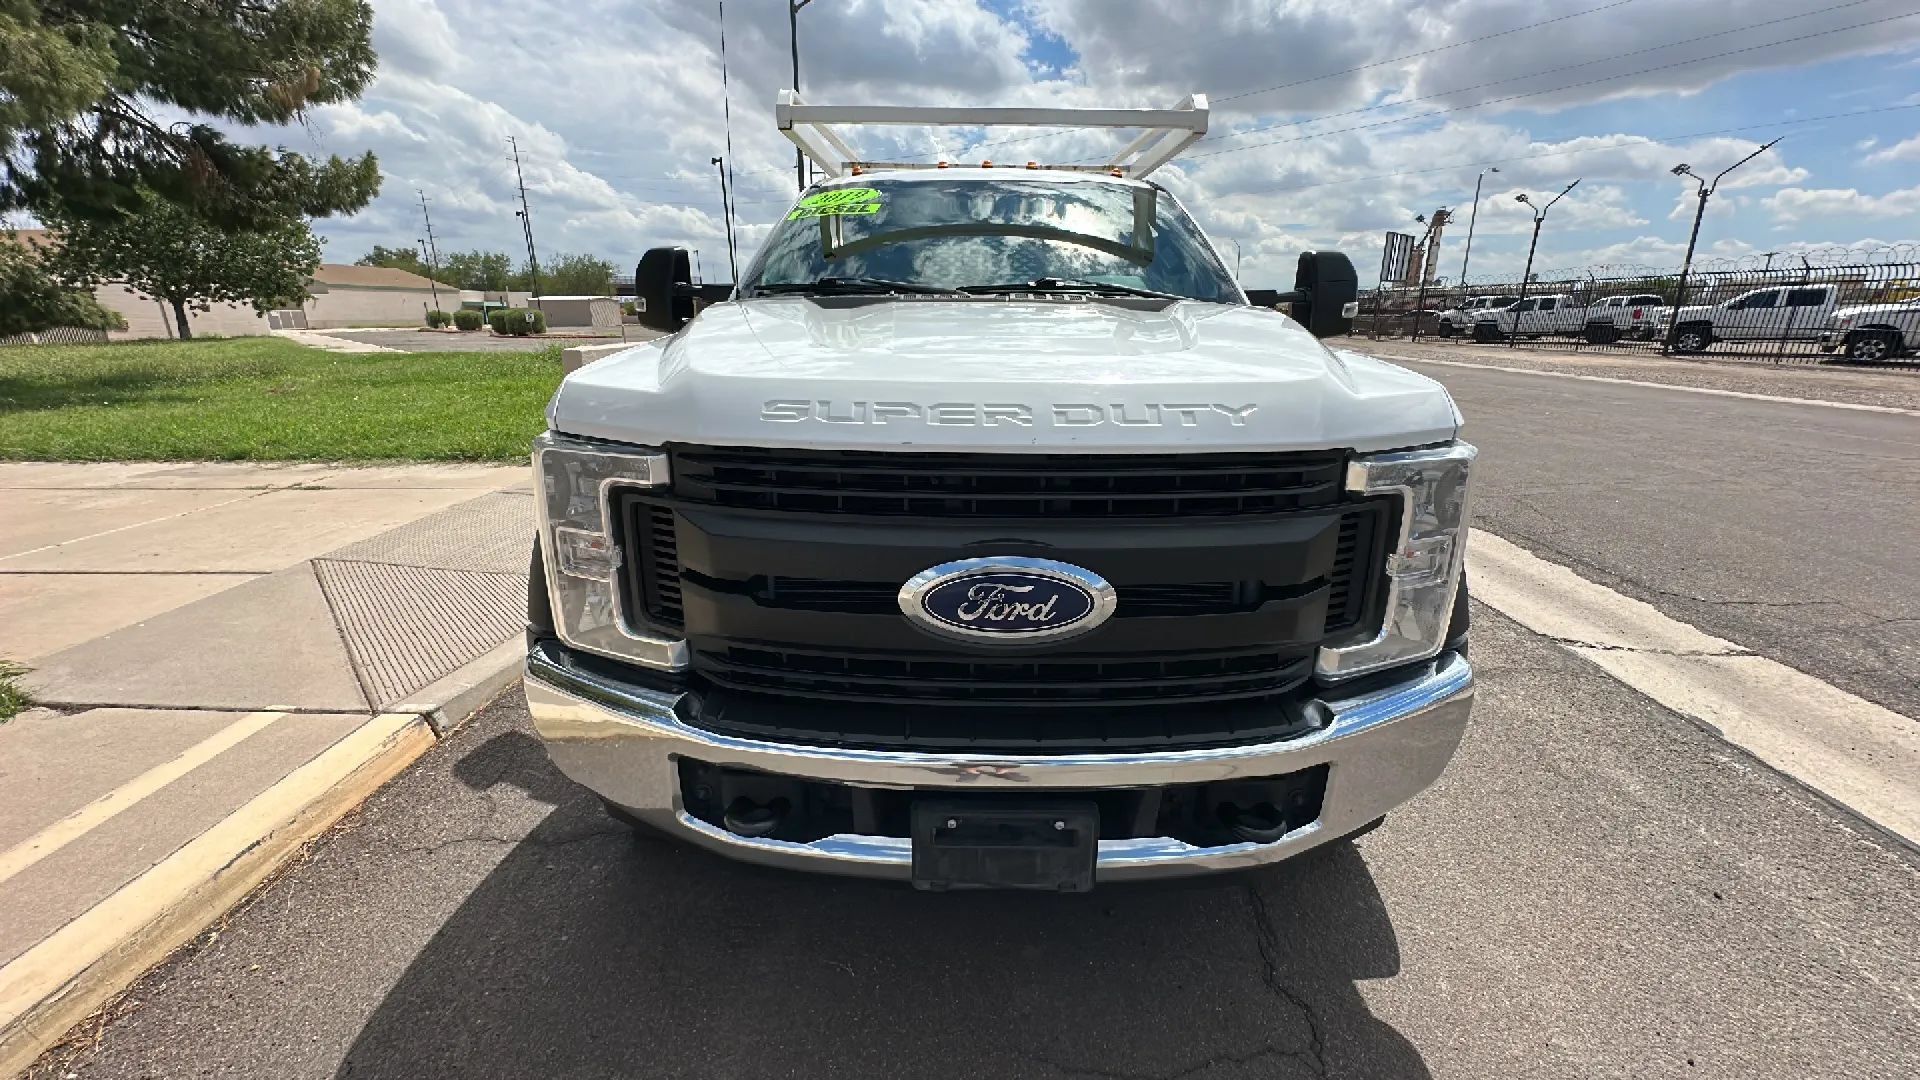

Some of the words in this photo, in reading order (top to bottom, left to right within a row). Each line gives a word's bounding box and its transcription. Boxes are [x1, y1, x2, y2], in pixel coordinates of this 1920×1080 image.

[760, 399, 1033, 427] SUPER
[1051, 402, 1259, 428] DUTY
[957, 582, 1060, 622] Ford
